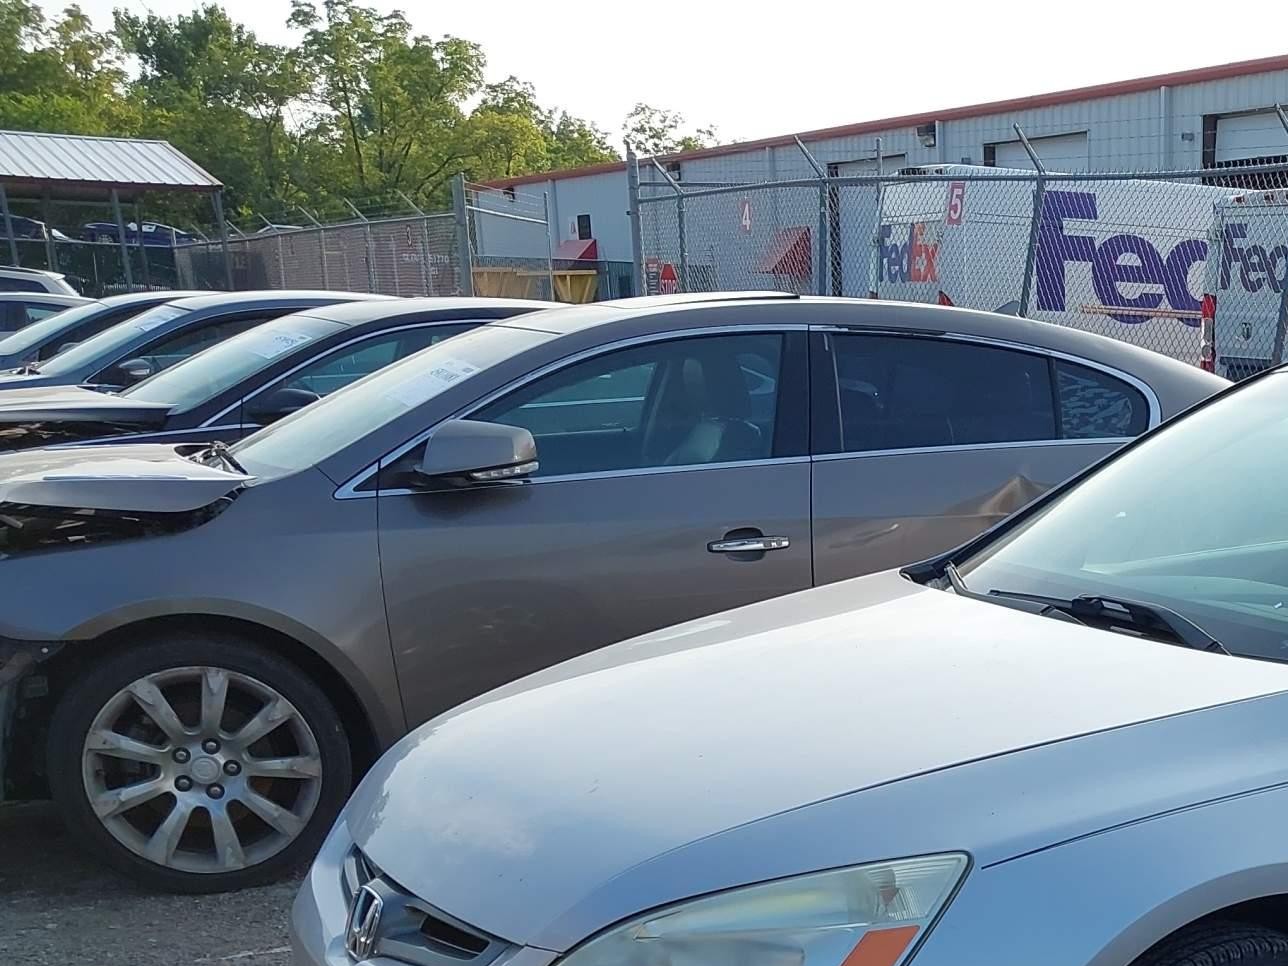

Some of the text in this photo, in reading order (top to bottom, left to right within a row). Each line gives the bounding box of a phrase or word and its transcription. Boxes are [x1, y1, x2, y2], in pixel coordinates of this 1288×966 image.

[742, 202, 751, 231] 4
[950, 188, 963, 220] 5
[879, 222, 940, 284] FedEx
